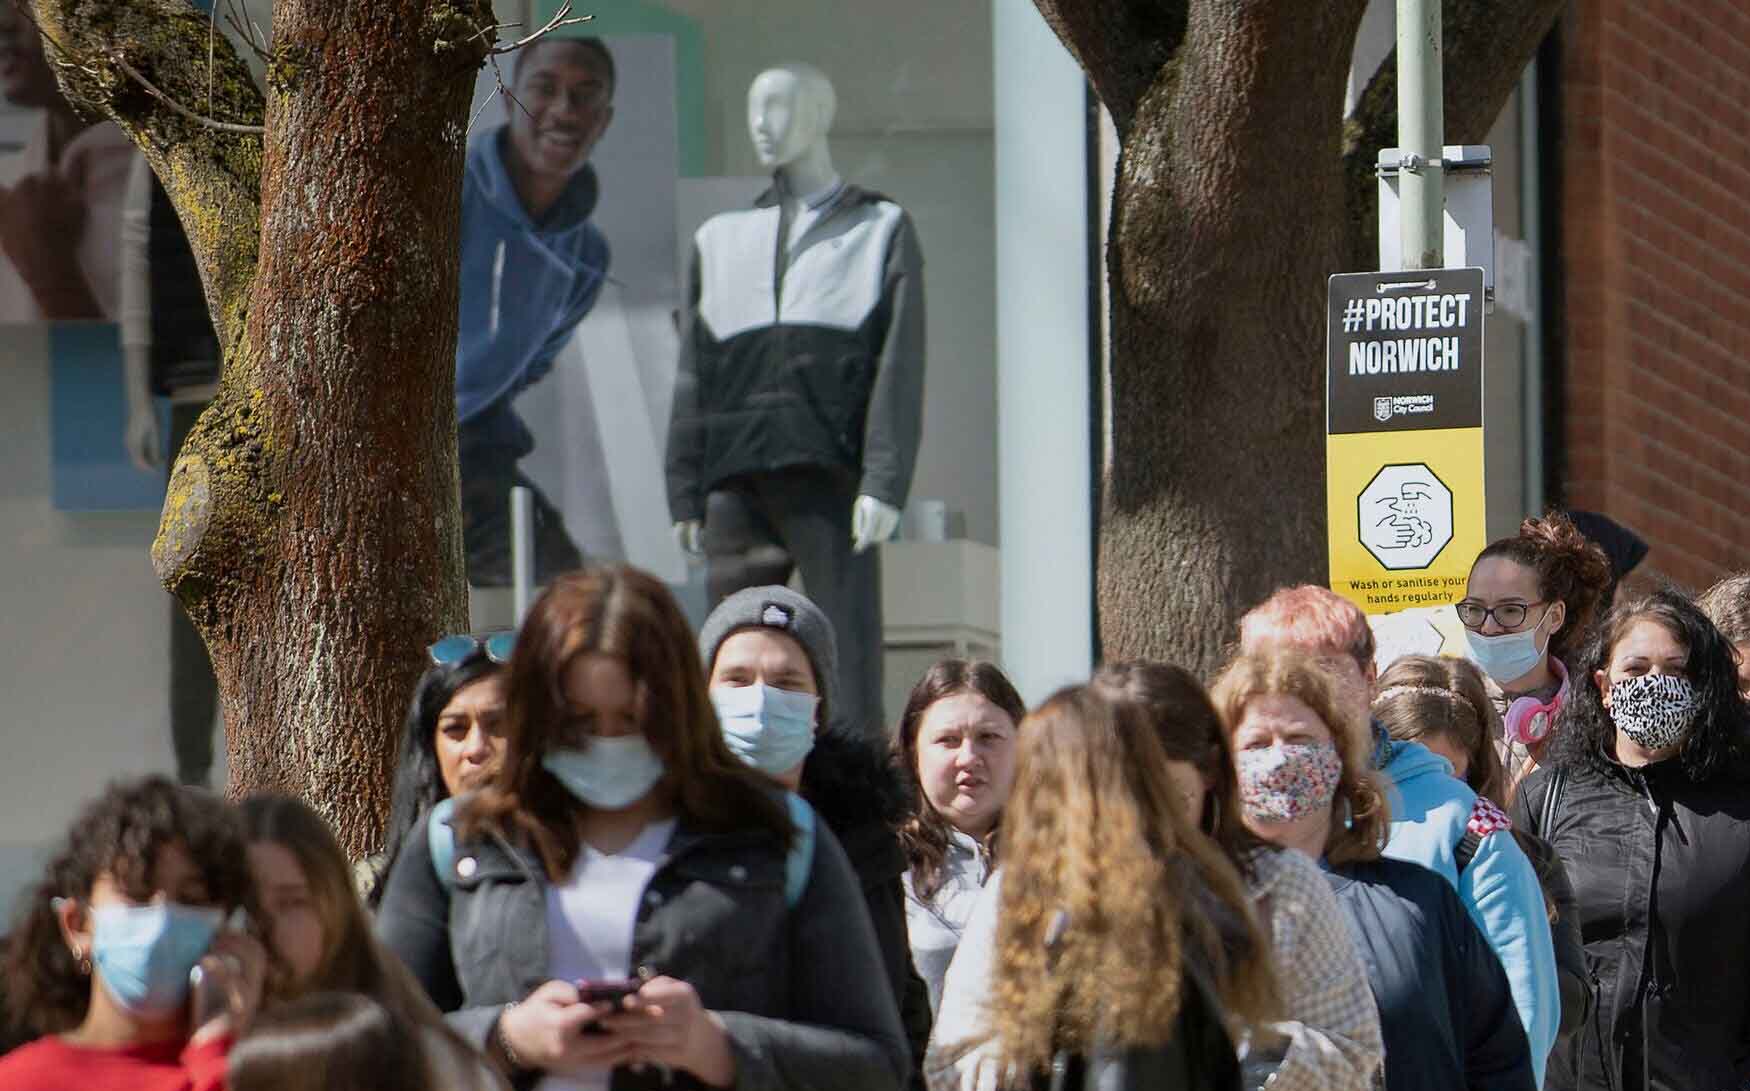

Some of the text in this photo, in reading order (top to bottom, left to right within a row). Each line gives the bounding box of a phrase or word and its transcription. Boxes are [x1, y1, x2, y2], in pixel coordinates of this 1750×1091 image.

[1342, 293, 1471, 333] #PROTECT
[1349, 336, 1460, 375] NORWICH
[1350, 576, 1467, 590] Wash or sanitise your
[1367, 591, 1454, 603] hands regularly
